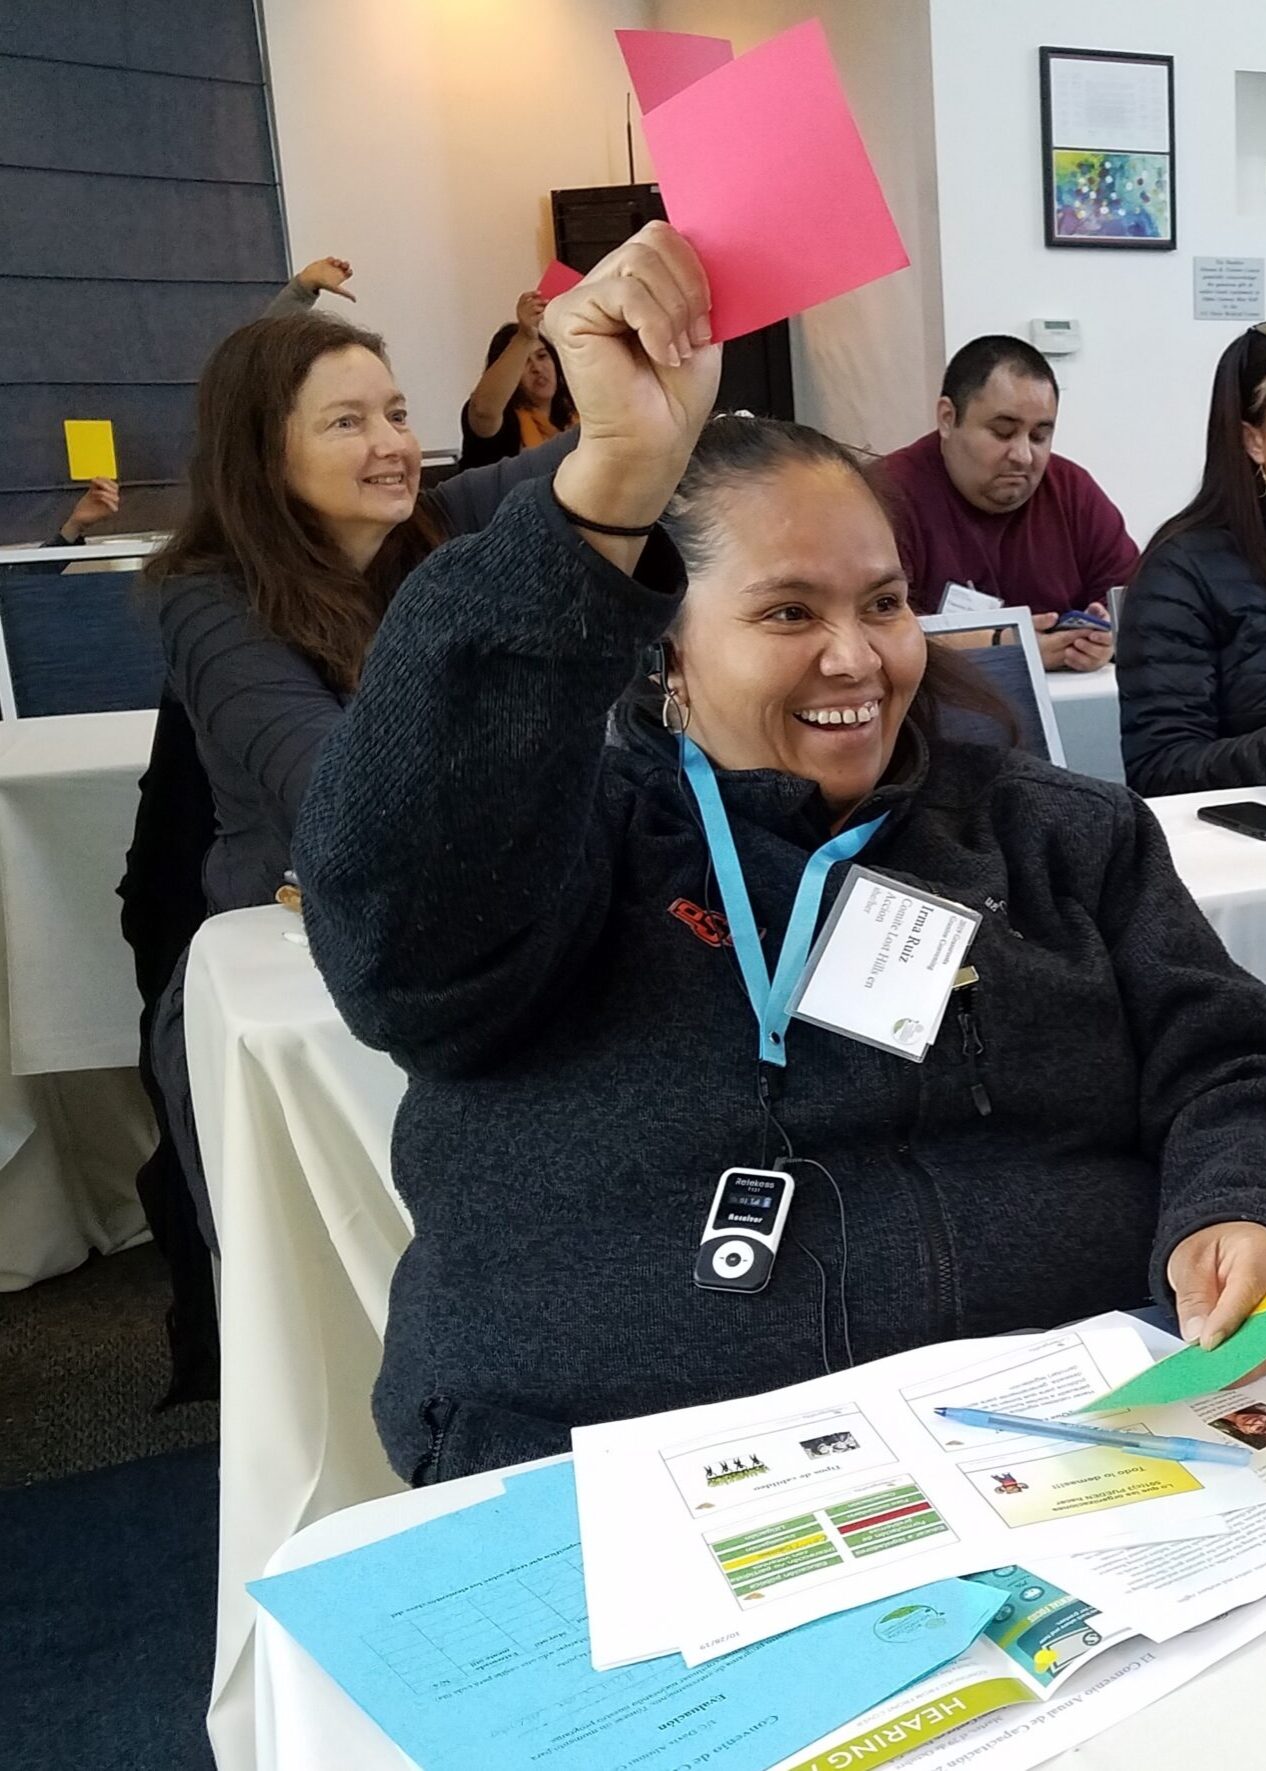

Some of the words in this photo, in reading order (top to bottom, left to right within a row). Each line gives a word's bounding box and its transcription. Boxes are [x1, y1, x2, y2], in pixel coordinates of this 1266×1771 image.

[874, 891, 897, 923] Accion
[888, 896, 912, 931] Comite
[910, 904, 934, 934] Irma
[879, 930, 898, 952] Lost
[897, 934, 919, 965] Ruiz
[869, 951, 887, 976] Hills
[863, 975, 874, 989] en
[727, 1213, 763, 1223] Receiver
[798, 1474, 811, 1482] de
[812, 1464, 841, 1477] Tipos
[1103, 1473, 1115, 1481] lo
[1117, 1466, 1145, 1478] Todo
[752, 1478, 796, 1493] cabildeo
[1084, 1487, 1126, 1501] PUEDEN
[1125, 1488, 1140, 1497] las
[1141, 1484, 1160, 1494] que
[1051, 1492, 1124, 1513] organizaciones
[1055, 1495, 1083, 1506] hacer
[698, 1630, 741, 1651] 10/28/19
[1141, 1651, 1156, 1665] El
[1083, 1660, 1141, 1696] Convenio
[657, 1693, 727, 1732] Evaluación
[1046, 1694, 1083, 1719] Anual
[1029, 1714, 1046, 1729] de
[712, 1714, 779, 1754] Convenio
[827, 1696, 966, 1769] HEARING
[946, 1722, 1031, 1769] Capacitación
[693, 1753, 711, 1765] de
